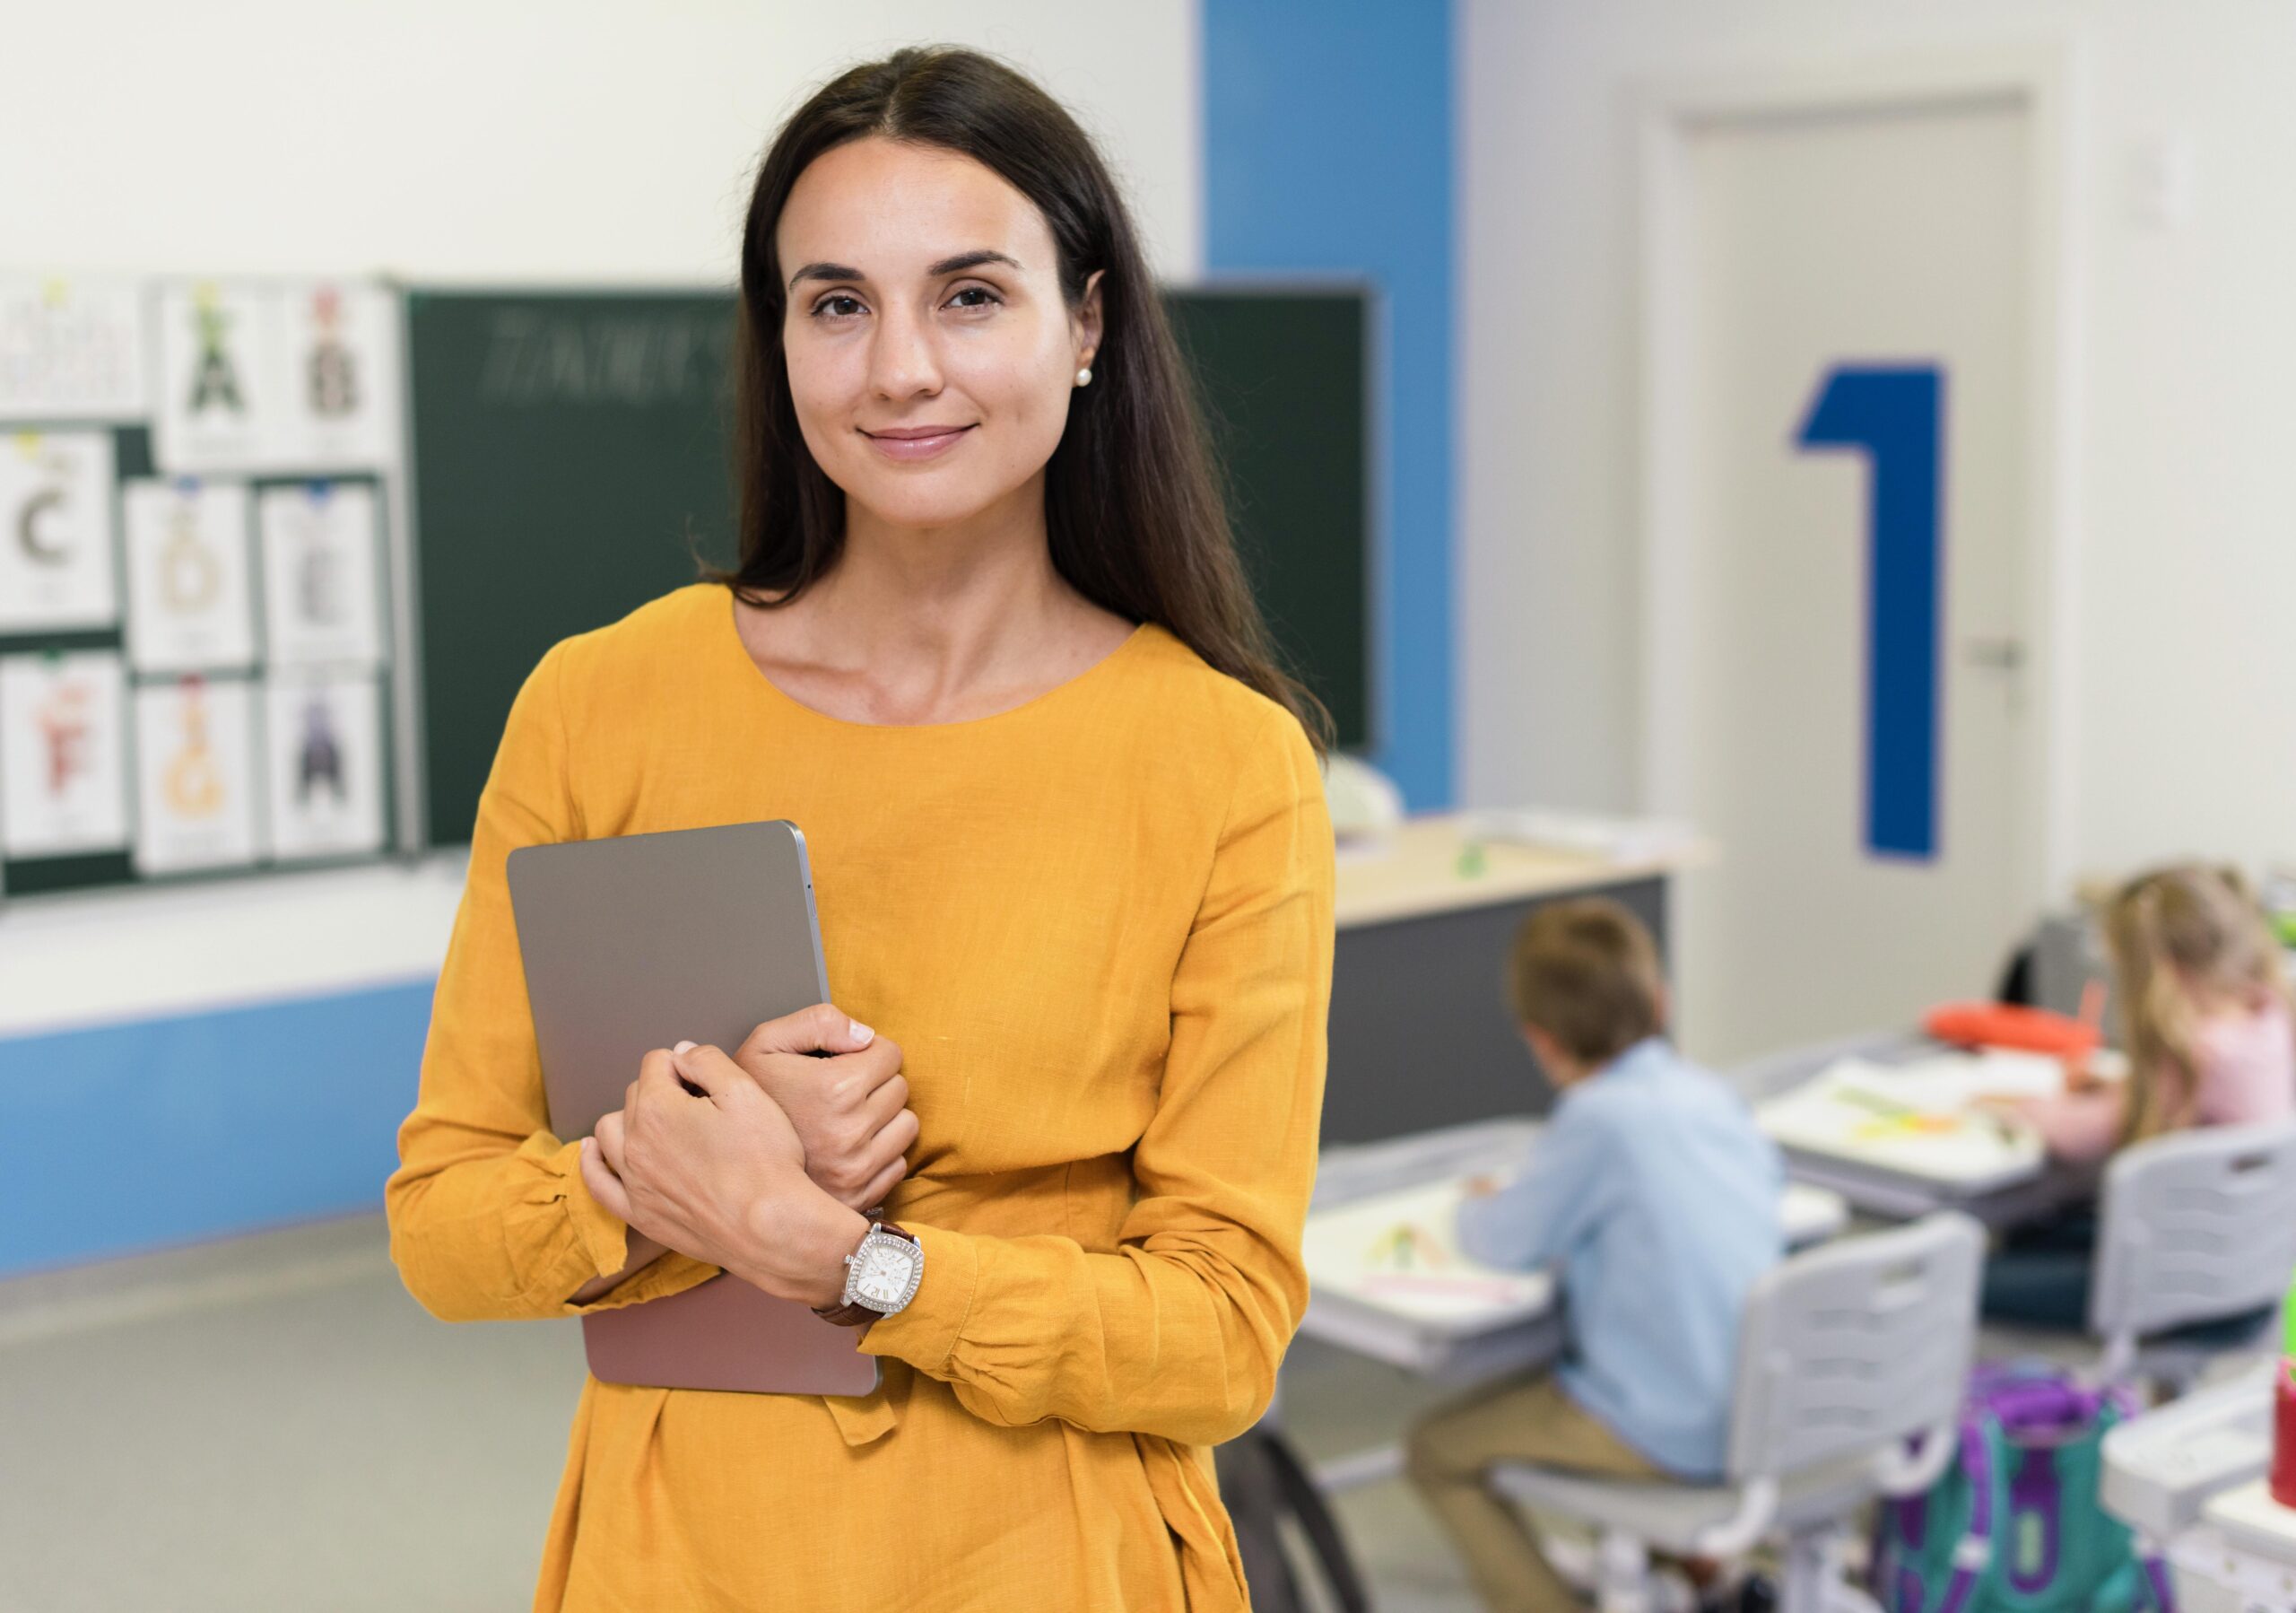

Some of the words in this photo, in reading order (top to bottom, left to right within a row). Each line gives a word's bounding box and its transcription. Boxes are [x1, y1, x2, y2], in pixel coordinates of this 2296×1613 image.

[186, 343, 247, 418] A
[15, 487, 72, 571] C
[1792, 362, 1943, 859] 1
